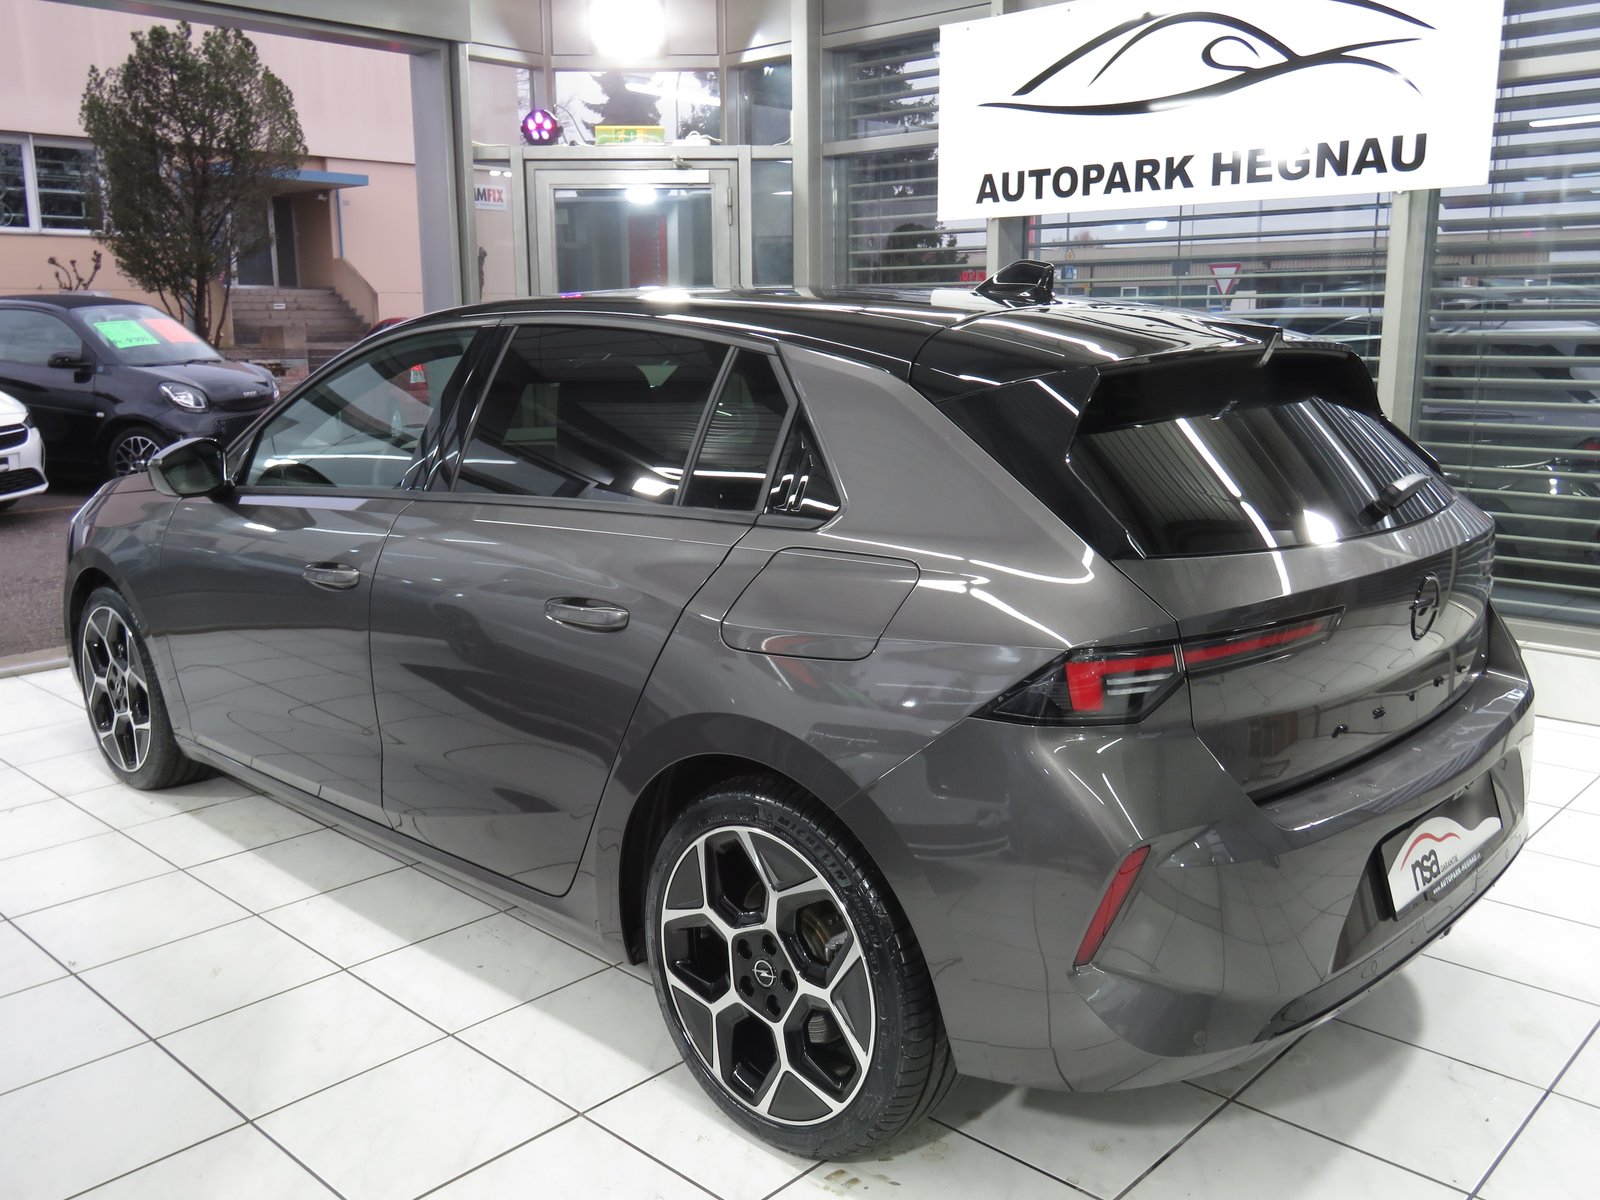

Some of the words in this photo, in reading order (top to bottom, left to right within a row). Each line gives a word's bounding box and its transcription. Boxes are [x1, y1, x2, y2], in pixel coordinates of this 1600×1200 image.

[976, 155, 1194, 204] AUTOPARK
[1211, 133, 1428, 187] HEGNAU
[1411, 848, 1441, 892] nsa
